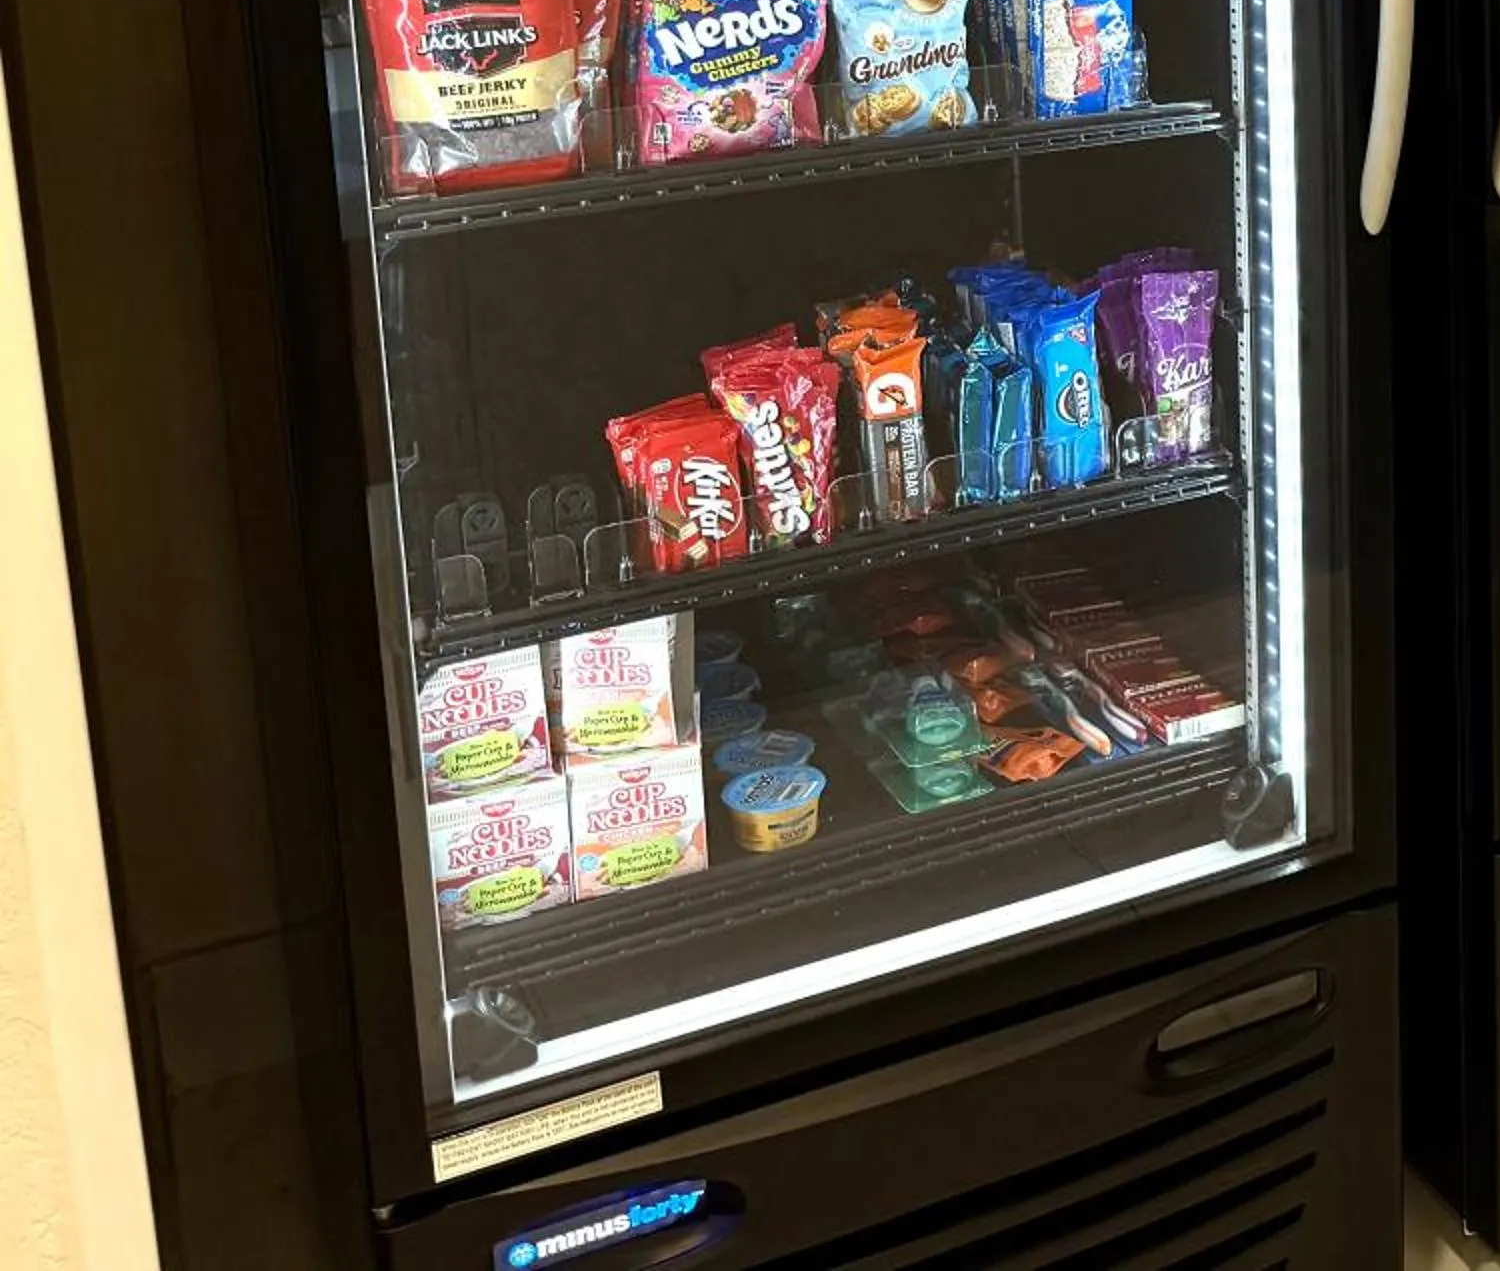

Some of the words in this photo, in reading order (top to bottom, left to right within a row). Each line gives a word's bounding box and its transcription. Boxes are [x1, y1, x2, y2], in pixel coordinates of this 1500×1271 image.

[417, 30, 473, 54] JACK
[690, 47, 762, 74] Gummy
[708, 54, 779, 82] Clusters
[438, 82, 478, 98] BEEF
[479, 78, 527, 95] JERKY
[750, 400, 811, 535] Skittles
[904, 471, 920, 498] BAR
[575, 646, 631, 670] CUP
[569, 663, 653, 688] OODLES
[443, 676, 504, 707] CUP
[421, 690, 527, 733] NOODLES
[609, 782, 667, 809] CUP
[587, 795, 687, 834] NOODLES
[471, 814, 531, 846] CUP
[448, 826, 553, 871] NOODLES
[536, 1189, 705, 1259] minusforty
